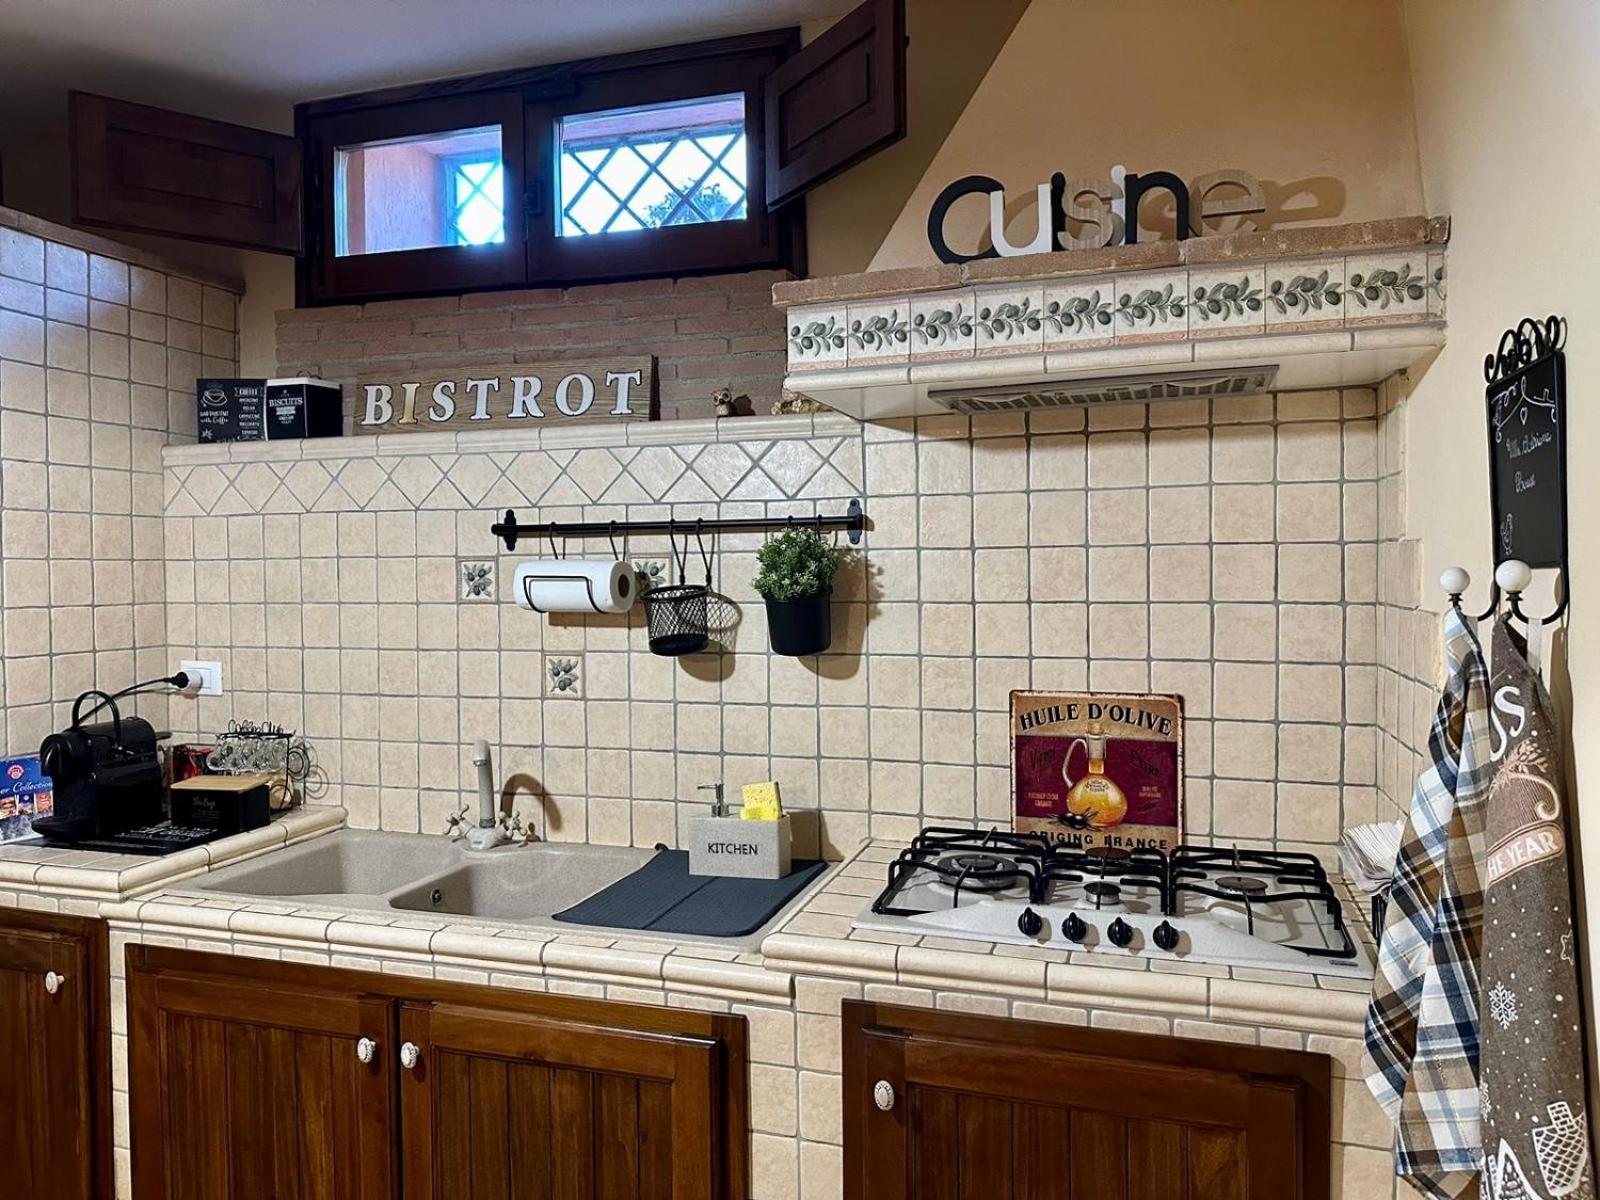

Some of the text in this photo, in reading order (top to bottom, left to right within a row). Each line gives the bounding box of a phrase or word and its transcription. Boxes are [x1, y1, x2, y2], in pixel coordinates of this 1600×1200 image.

[268, 397, 303, 408] BISCUITS
[360, 368, 642, 426] BISTROT
[1019, 703, 1174, 736] HUILE D'OLIVE
[13, 781, 53, 793] Collection
[707, 842, 759, 856] KITCHEN
[1506, 831, 1559, 866] YEAR
